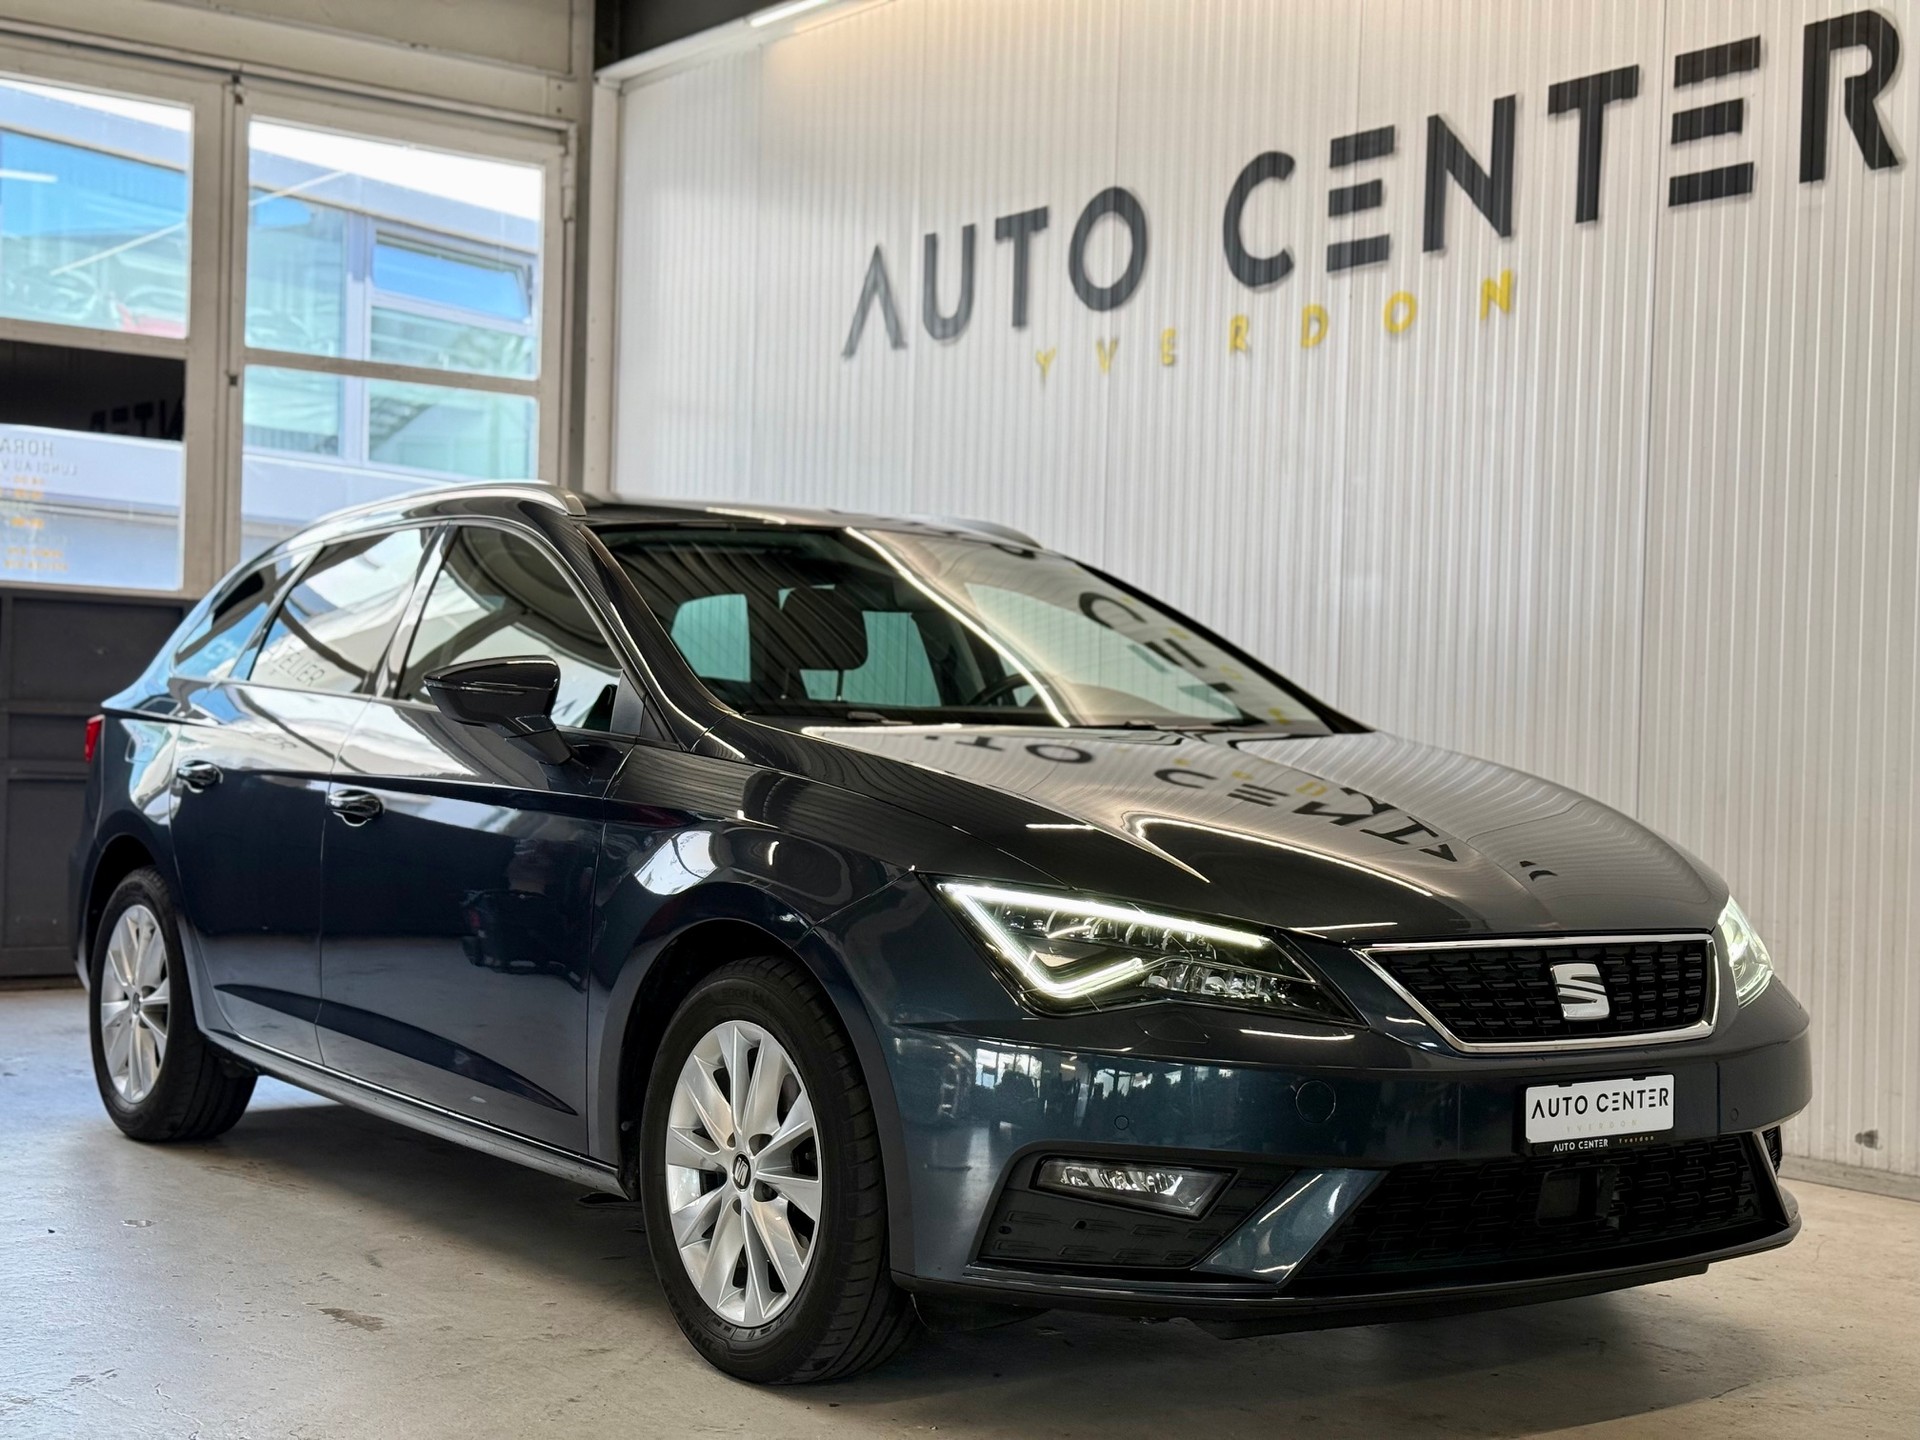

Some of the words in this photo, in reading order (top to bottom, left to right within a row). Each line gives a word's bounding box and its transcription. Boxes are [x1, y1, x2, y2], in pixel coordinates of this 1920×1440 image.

[841, 186, 1148, 360] AUTO
[1222, 8, 1902, 291] CENTER
[1035, 269, 1514, 380] YVERDON
[1531, 1094, 1589, 1120] AUTO
[1596, 1087, 1669, 1113] CENTER
[1566, 1119, 1639, 1133] YVERDON
[1552, 1141, 1576, 1153] AUTO
[1578, 1138, 1609, 1150] CENTER
